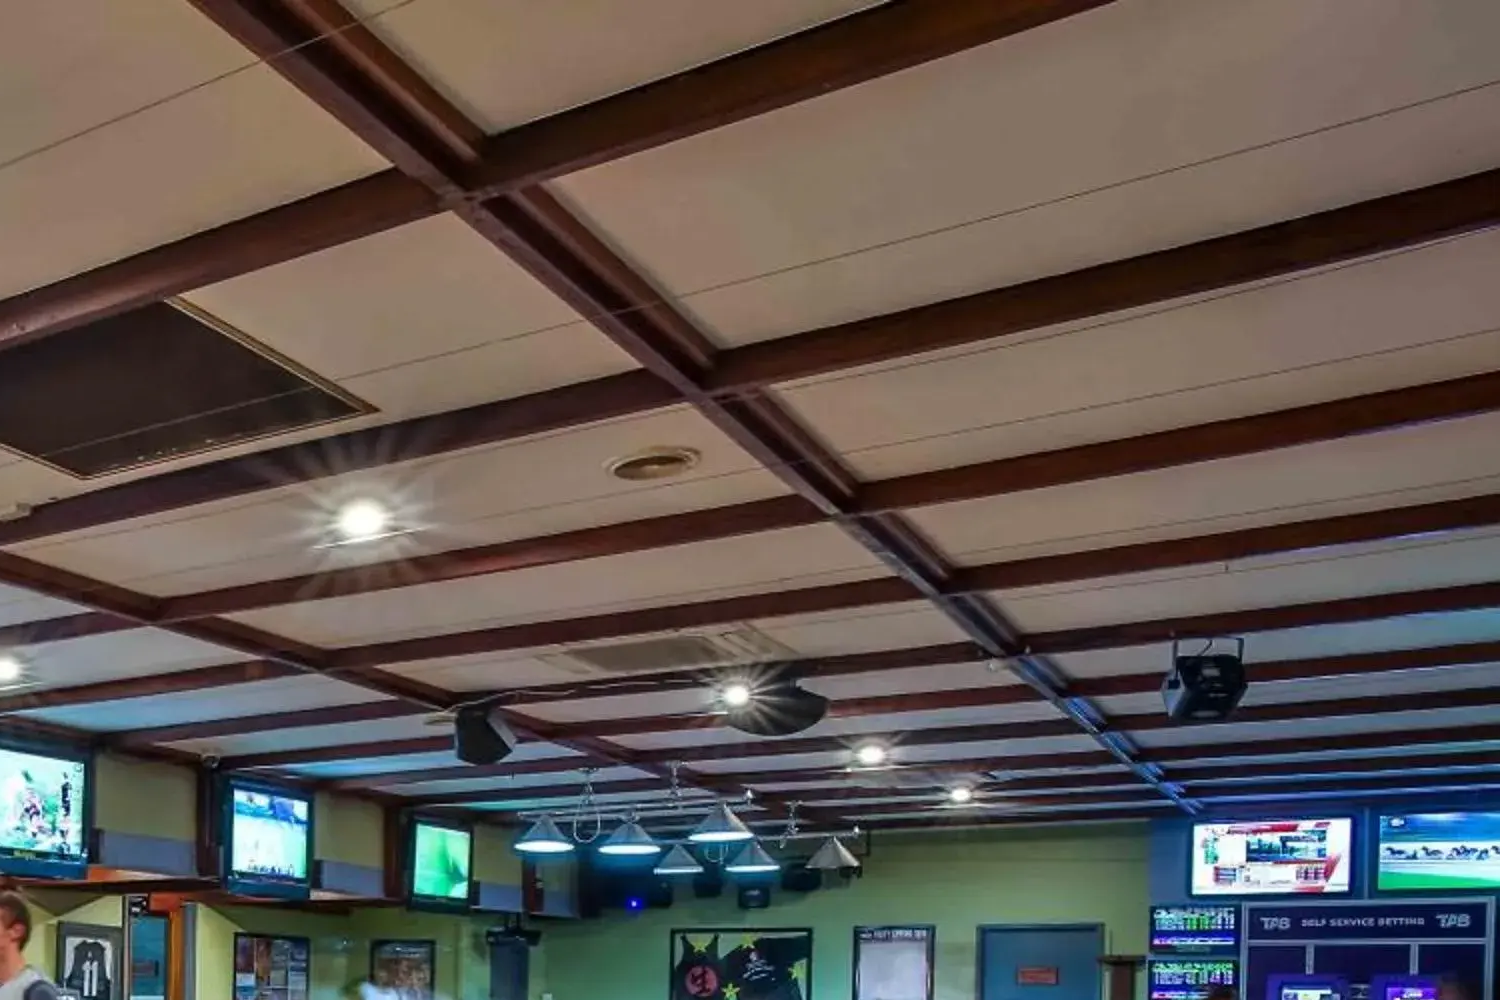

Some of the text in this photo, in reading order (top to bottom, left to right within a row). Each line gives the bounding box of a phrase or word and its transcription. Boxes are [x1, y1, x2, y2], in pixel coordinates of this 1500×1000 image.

[1260, 913, 1472, 930] TAB SELF SERVICE BETTING TAB
[82, 960, 99, 997] 11
